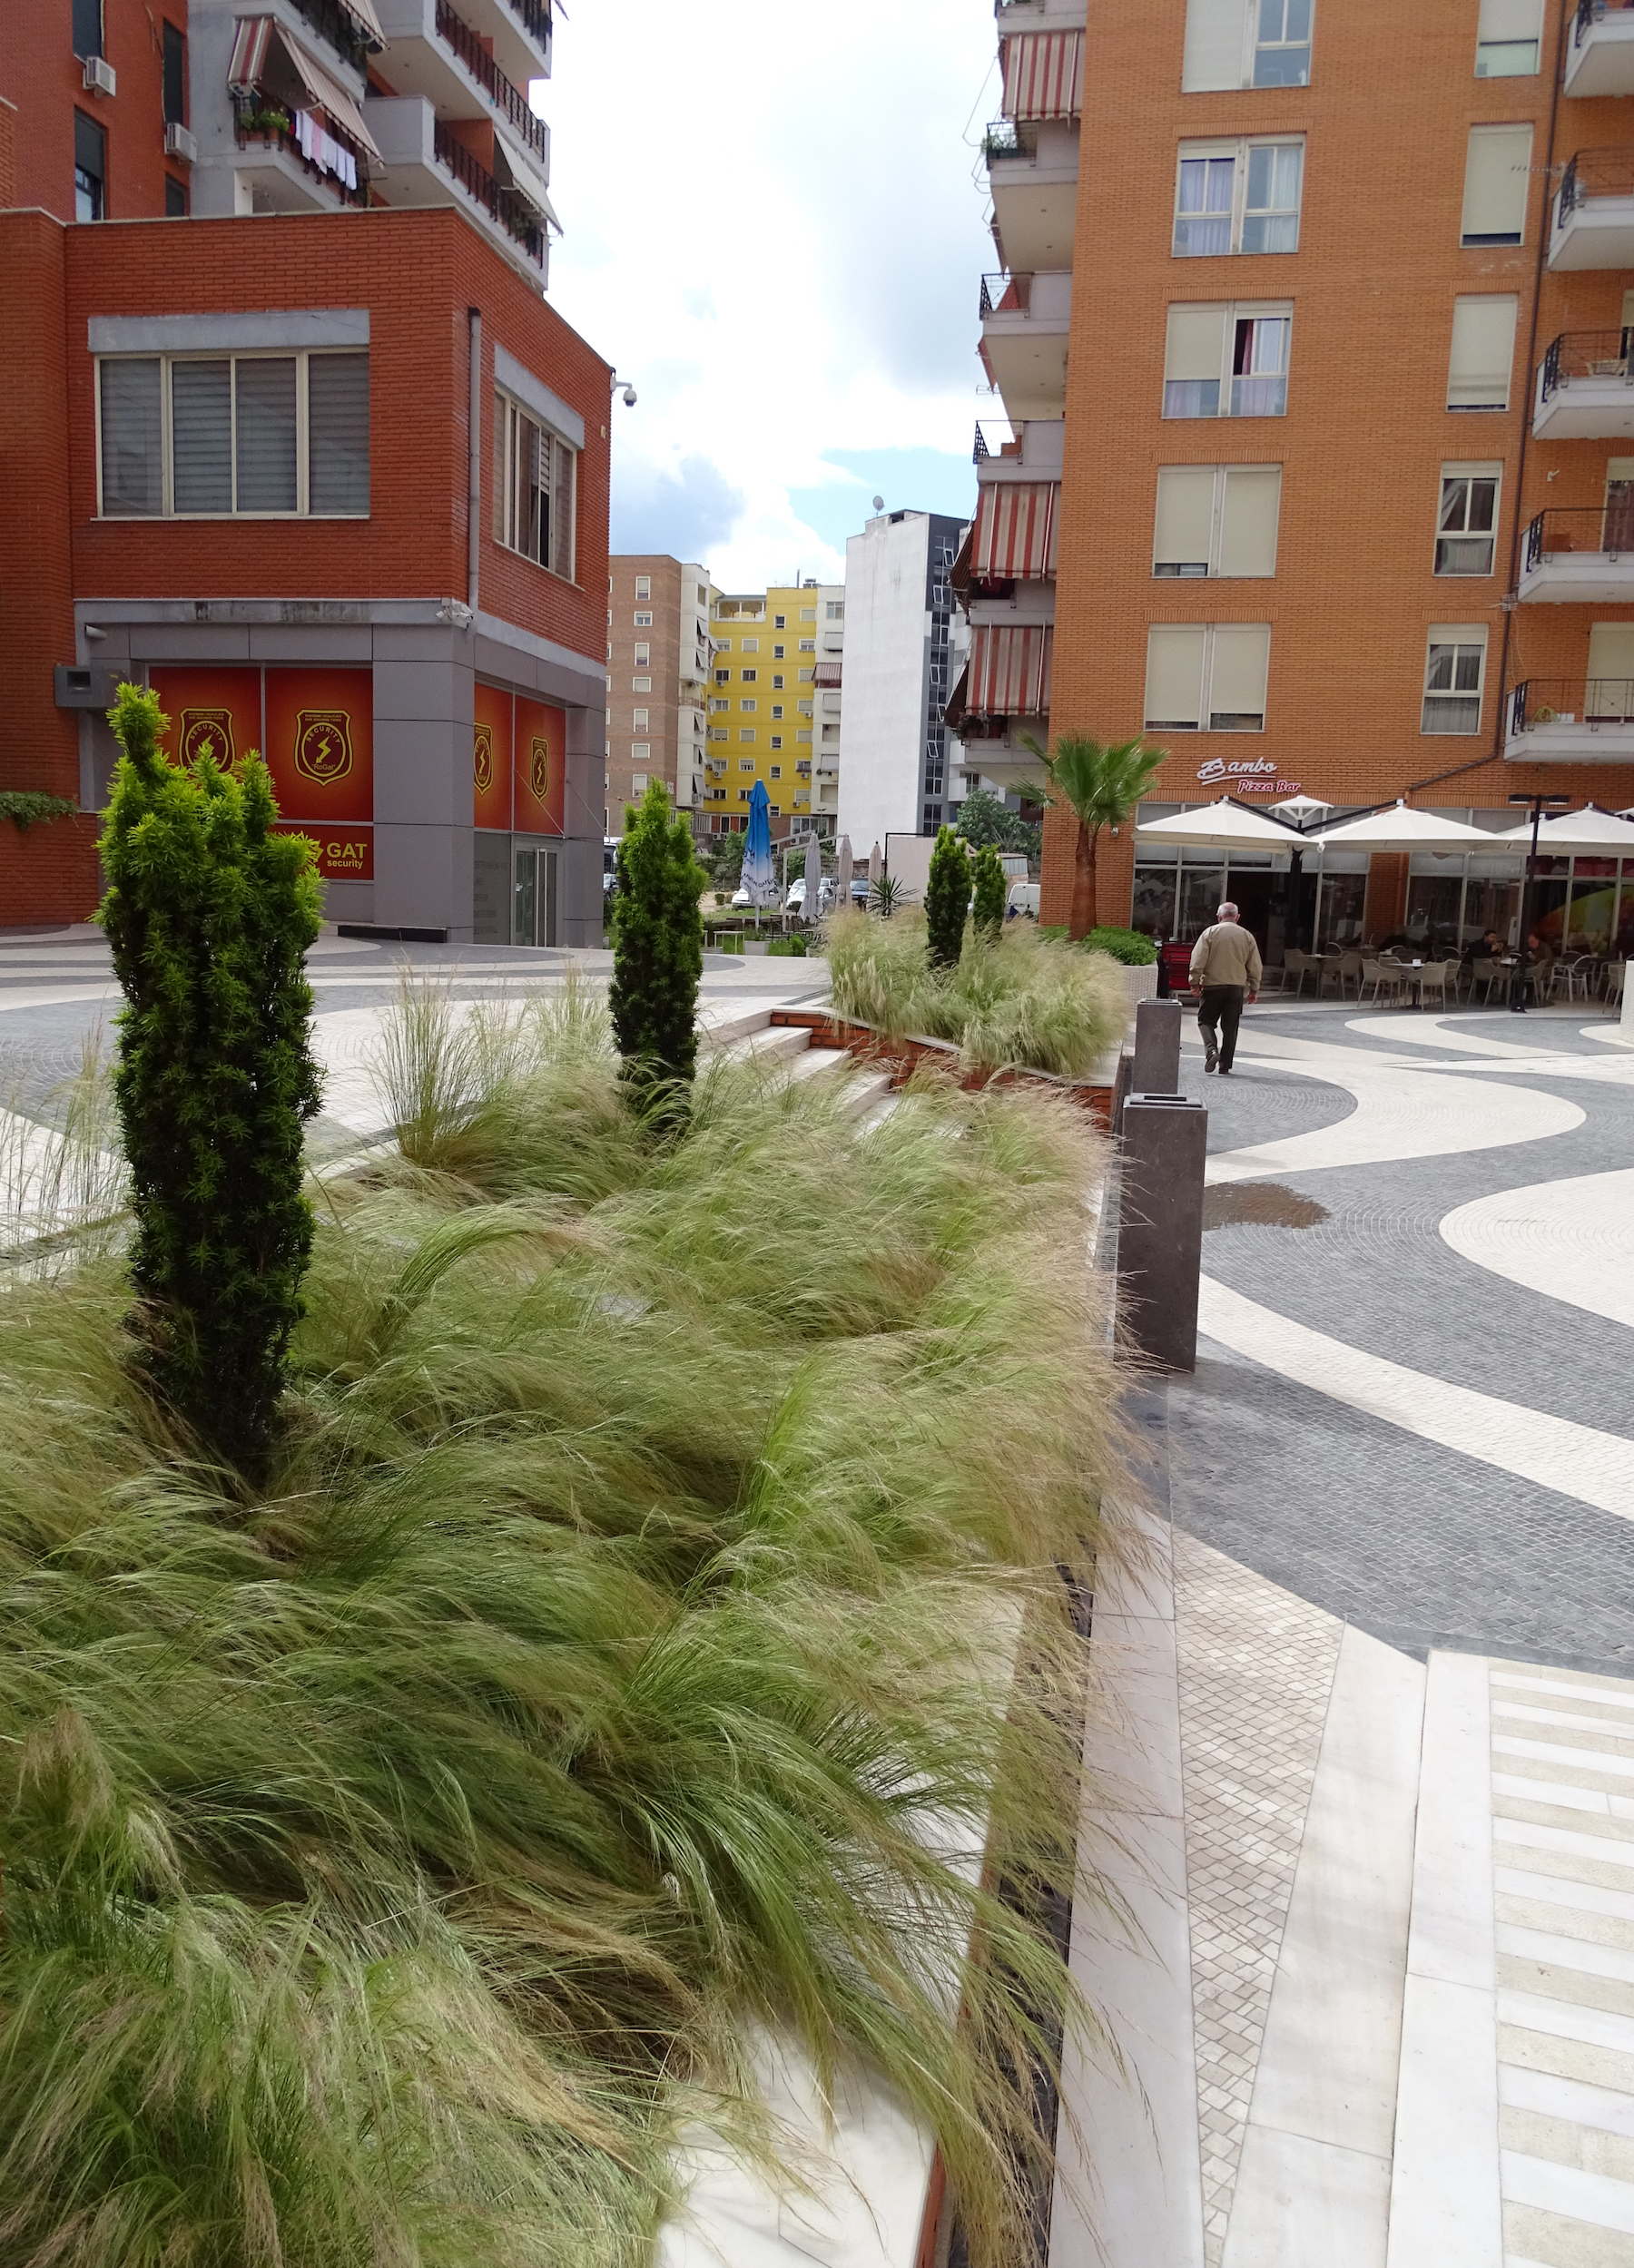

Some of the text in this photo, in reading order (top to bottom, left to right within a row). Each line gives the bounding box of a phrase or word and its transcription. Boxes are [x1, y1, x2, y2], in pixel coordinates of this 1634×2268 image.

[189, 724, 224, 741] SECURITY
[306, 725, 341, 743] SECURITY
[1196, 756, 1278, 780] Bambo
[1237, 780, 1301, 794] Pizza Bar
[326, 842, 368, 859] GAT
[327, 859, 363, 869] security
